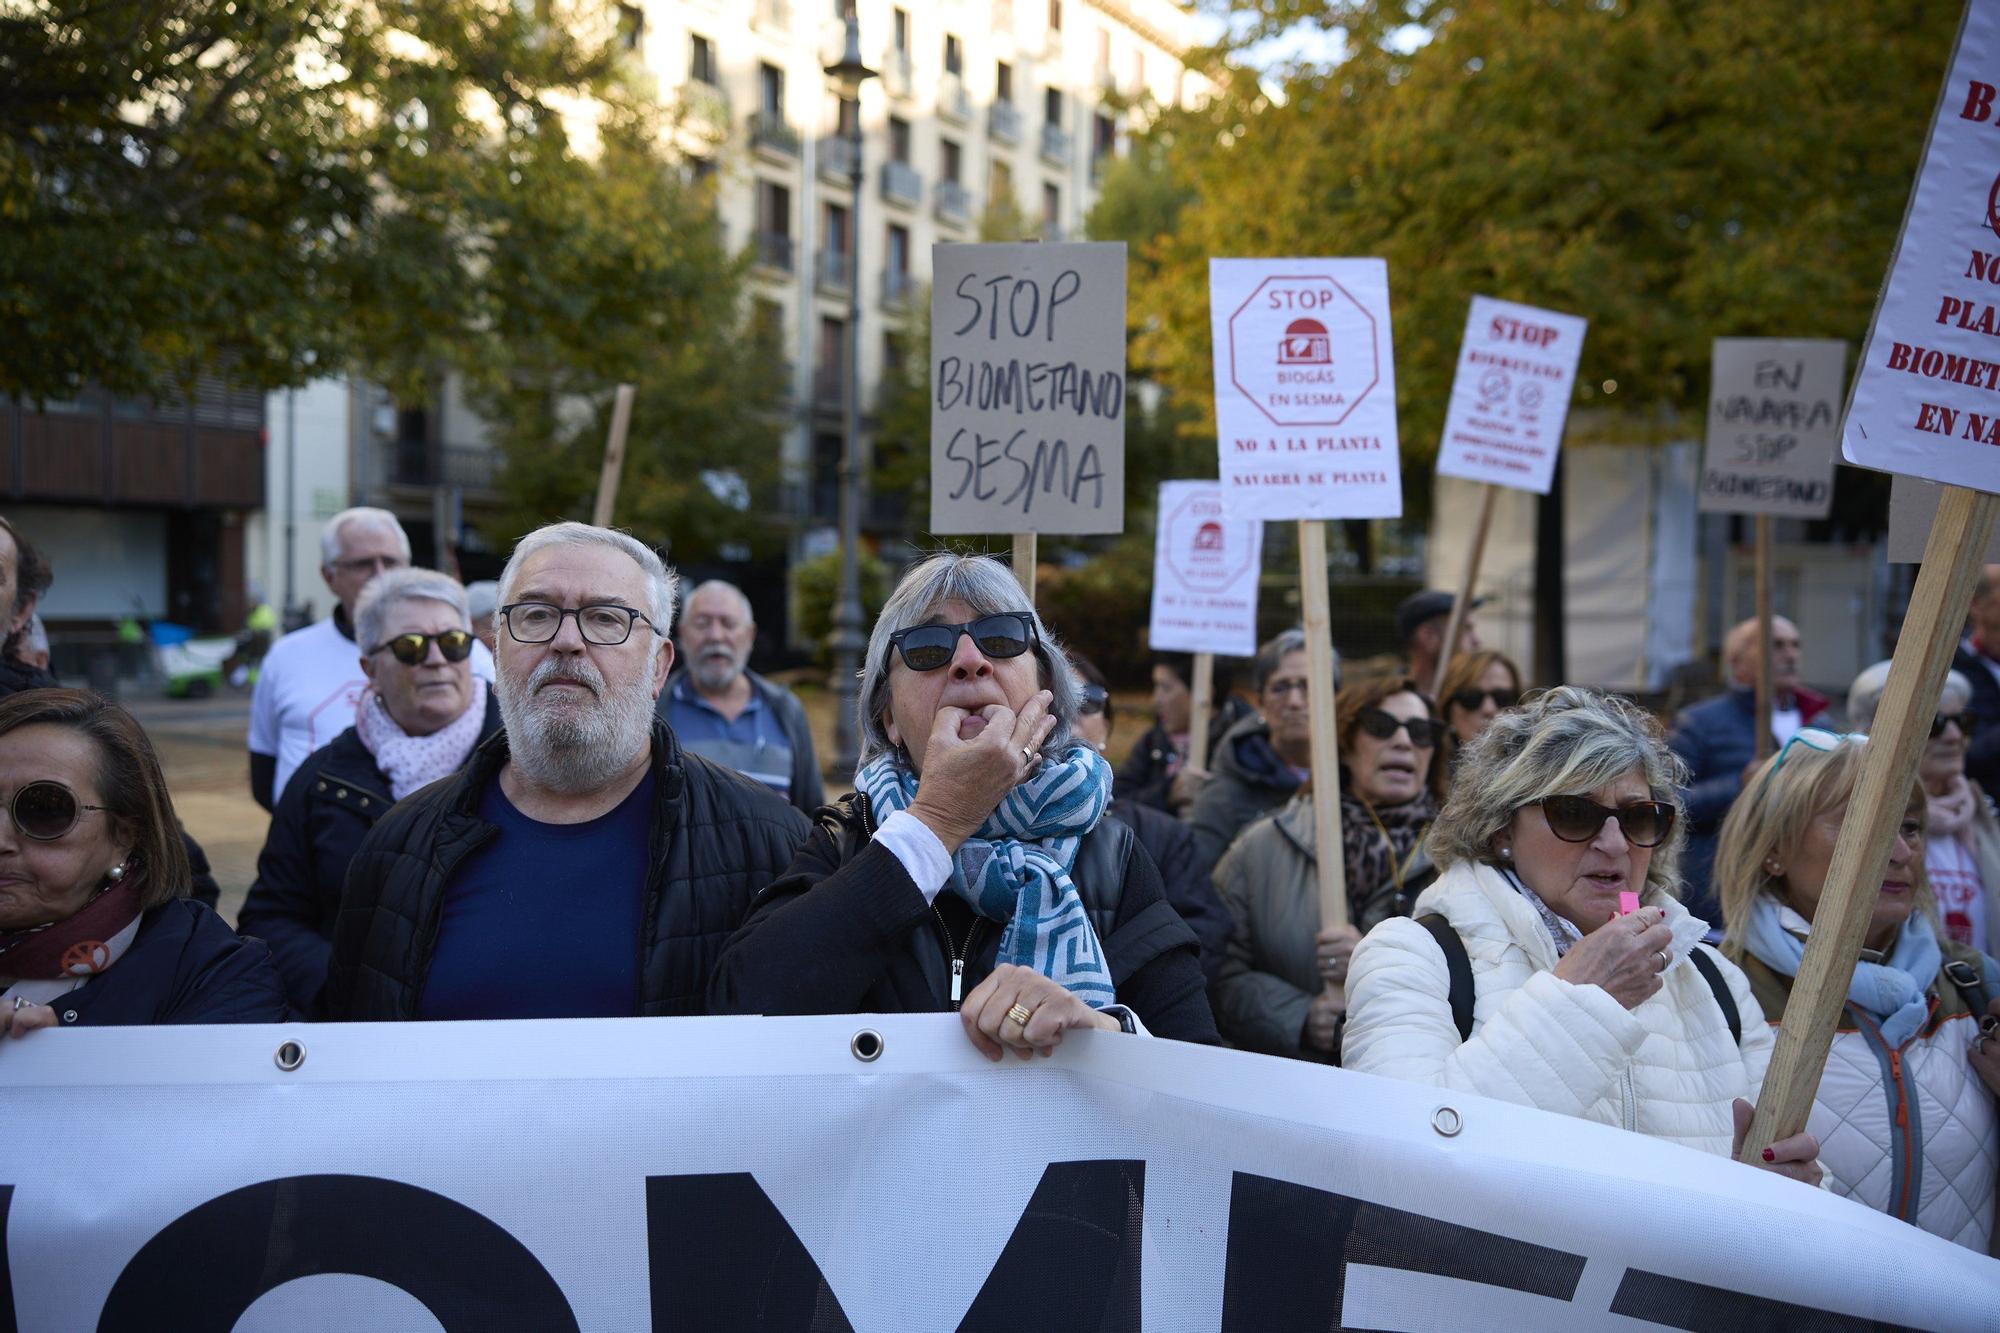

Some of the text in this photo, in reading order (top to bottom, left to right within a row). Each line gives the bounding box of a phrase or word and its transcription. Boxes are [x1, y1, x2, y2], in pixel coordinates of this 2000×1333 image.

[954, 270, 1081, 341] STOP
[1269, 290, 1333, 310] STOP
[1936, 296, 2000, 337] PLA
[1489, 314, 1560, 350] STOP
[937, 356, 1123, 420] BIOMETANO
[1277, 368, 1335, 384] BIOGÁS
[1754, 358, 1804, 391] EN
[1269, 392, 1345, 406] EN SESMA
[1914, 403, 1960, 436] EN
[1235, 436, 1381, 452] NO A LA PLANTA
[946, 428, 1105, 513] SESMA
[1233, 471, 1387, 486] NAVARRA SE PLANTA
